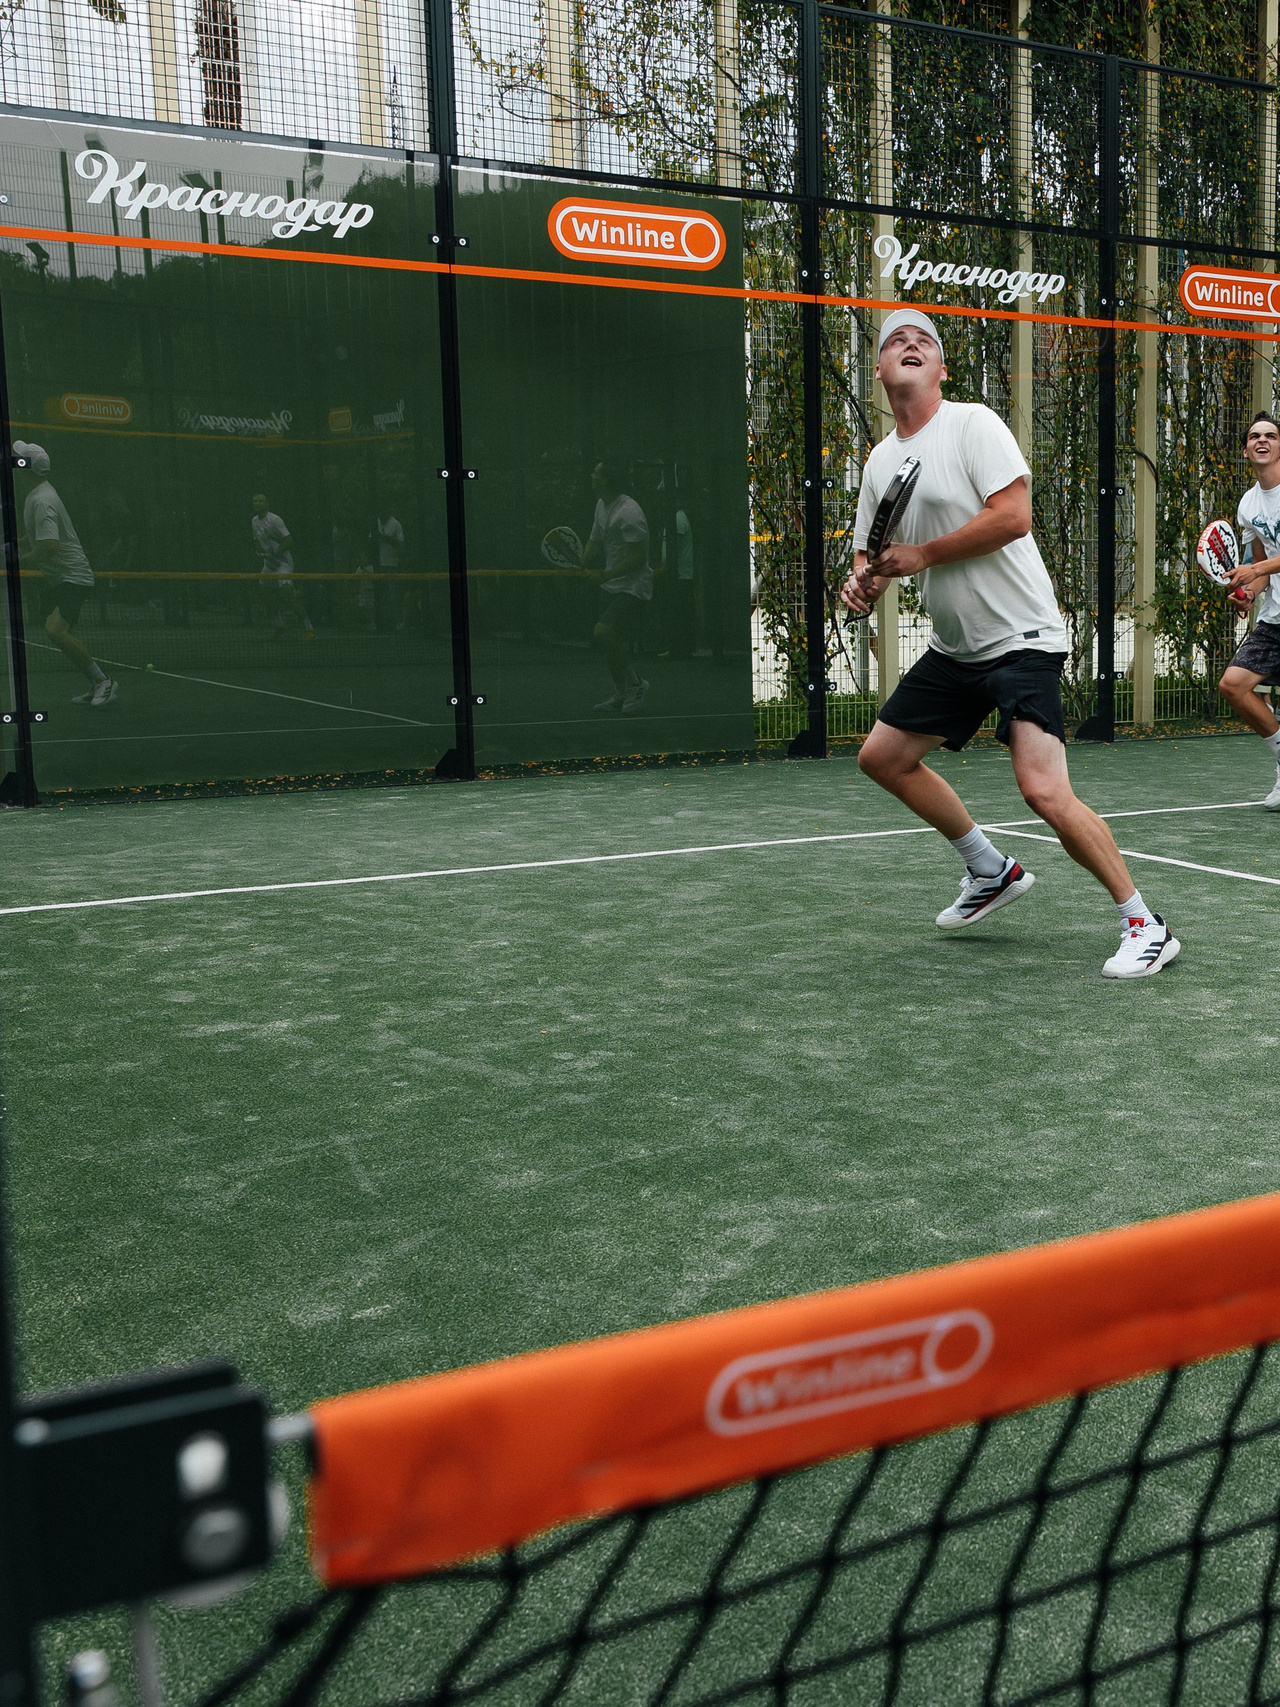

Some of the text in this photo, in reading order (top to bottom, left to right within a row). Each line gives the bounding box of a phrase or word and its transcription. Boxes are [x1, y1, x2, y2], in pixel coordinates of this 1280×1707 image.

[74, 148, 375, 240] Краснодар
[571, 216, 676, 250] Winline
[873, 234, 1066, 304] Краснодар
[1193, 280, 1265, 308] Winline
